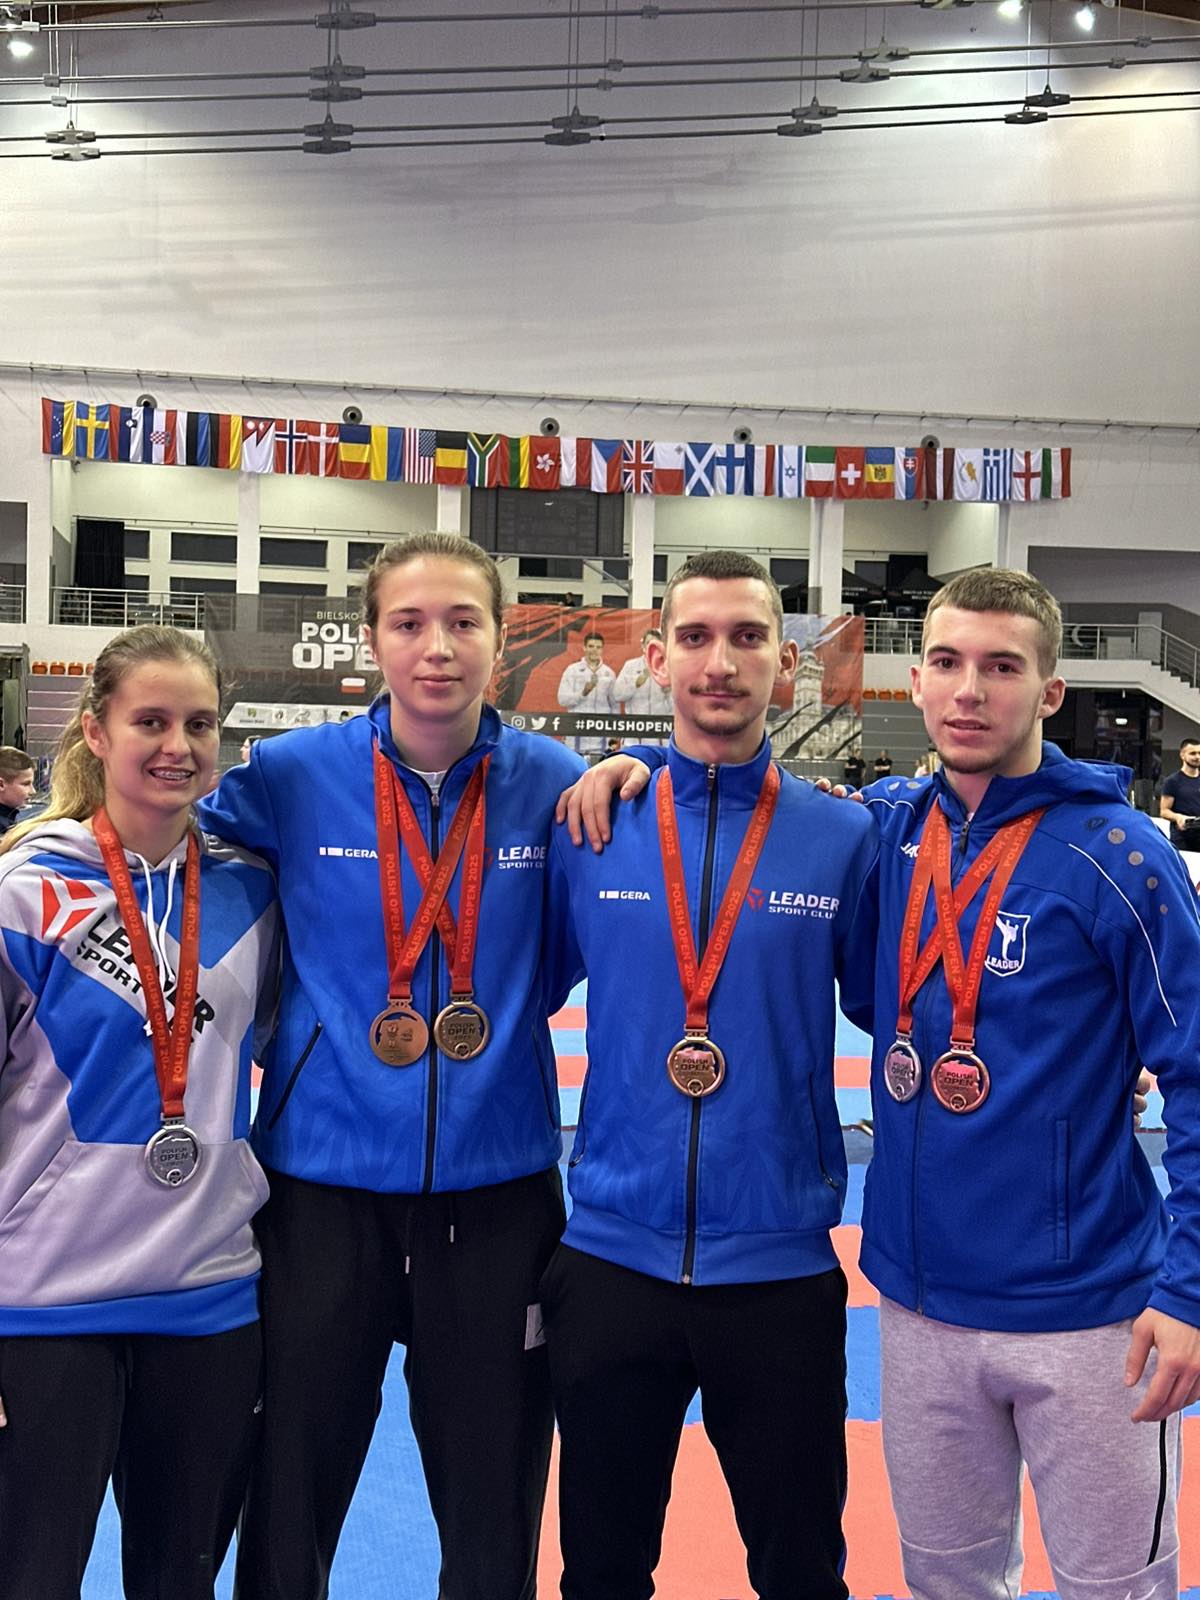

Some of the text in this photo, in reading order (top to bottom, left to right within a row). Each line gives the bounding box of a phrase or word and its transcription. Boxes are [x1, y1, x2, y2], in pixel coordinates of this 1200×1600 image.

[316, 611, 359, 621] BIELSKO
[301, 622, 366, 644] POLI
[292, 642, 379, 671] OPE
[575, 719, 673, 733] #POLISHOPEN
[344, 848, 378, 859] GERA
[498, 845, 547, 861] LEADE
[744, 825, 764, 864] POLISH
[386, 853, 398, 896] POLISH
[461, 854, 479, 962] POLISH OPEN 2025
[620, 890, 651, 901] GERA
[672, 882, 685, 925] POLISH
[769, 890, 840, 911] LEADER
[389, 899, 402, 931] OPEN
[402, 865, 450, 967] POLISH OPEN 2025
[768, 905, 835, 920] SPORT CLU
[678, 928, 691, 961] OPEN
[698, 890, 741, 996] POLISH OPEN 2025
[941, 895, 954, 939] POLISH
[948, 942, 960, 975] OPEN
[963, 895, 998, 1007] POLISH OPEN 2025
[987, 955, 1020, 970] LEADER
[172, 969, 193, 1082] POLISH OPEN 2025
[447, 1028, 476, 1036] OPEN
[944, 1077, 974, 1087] OPEN
[160, 1153, 188, 1162] OPEN
